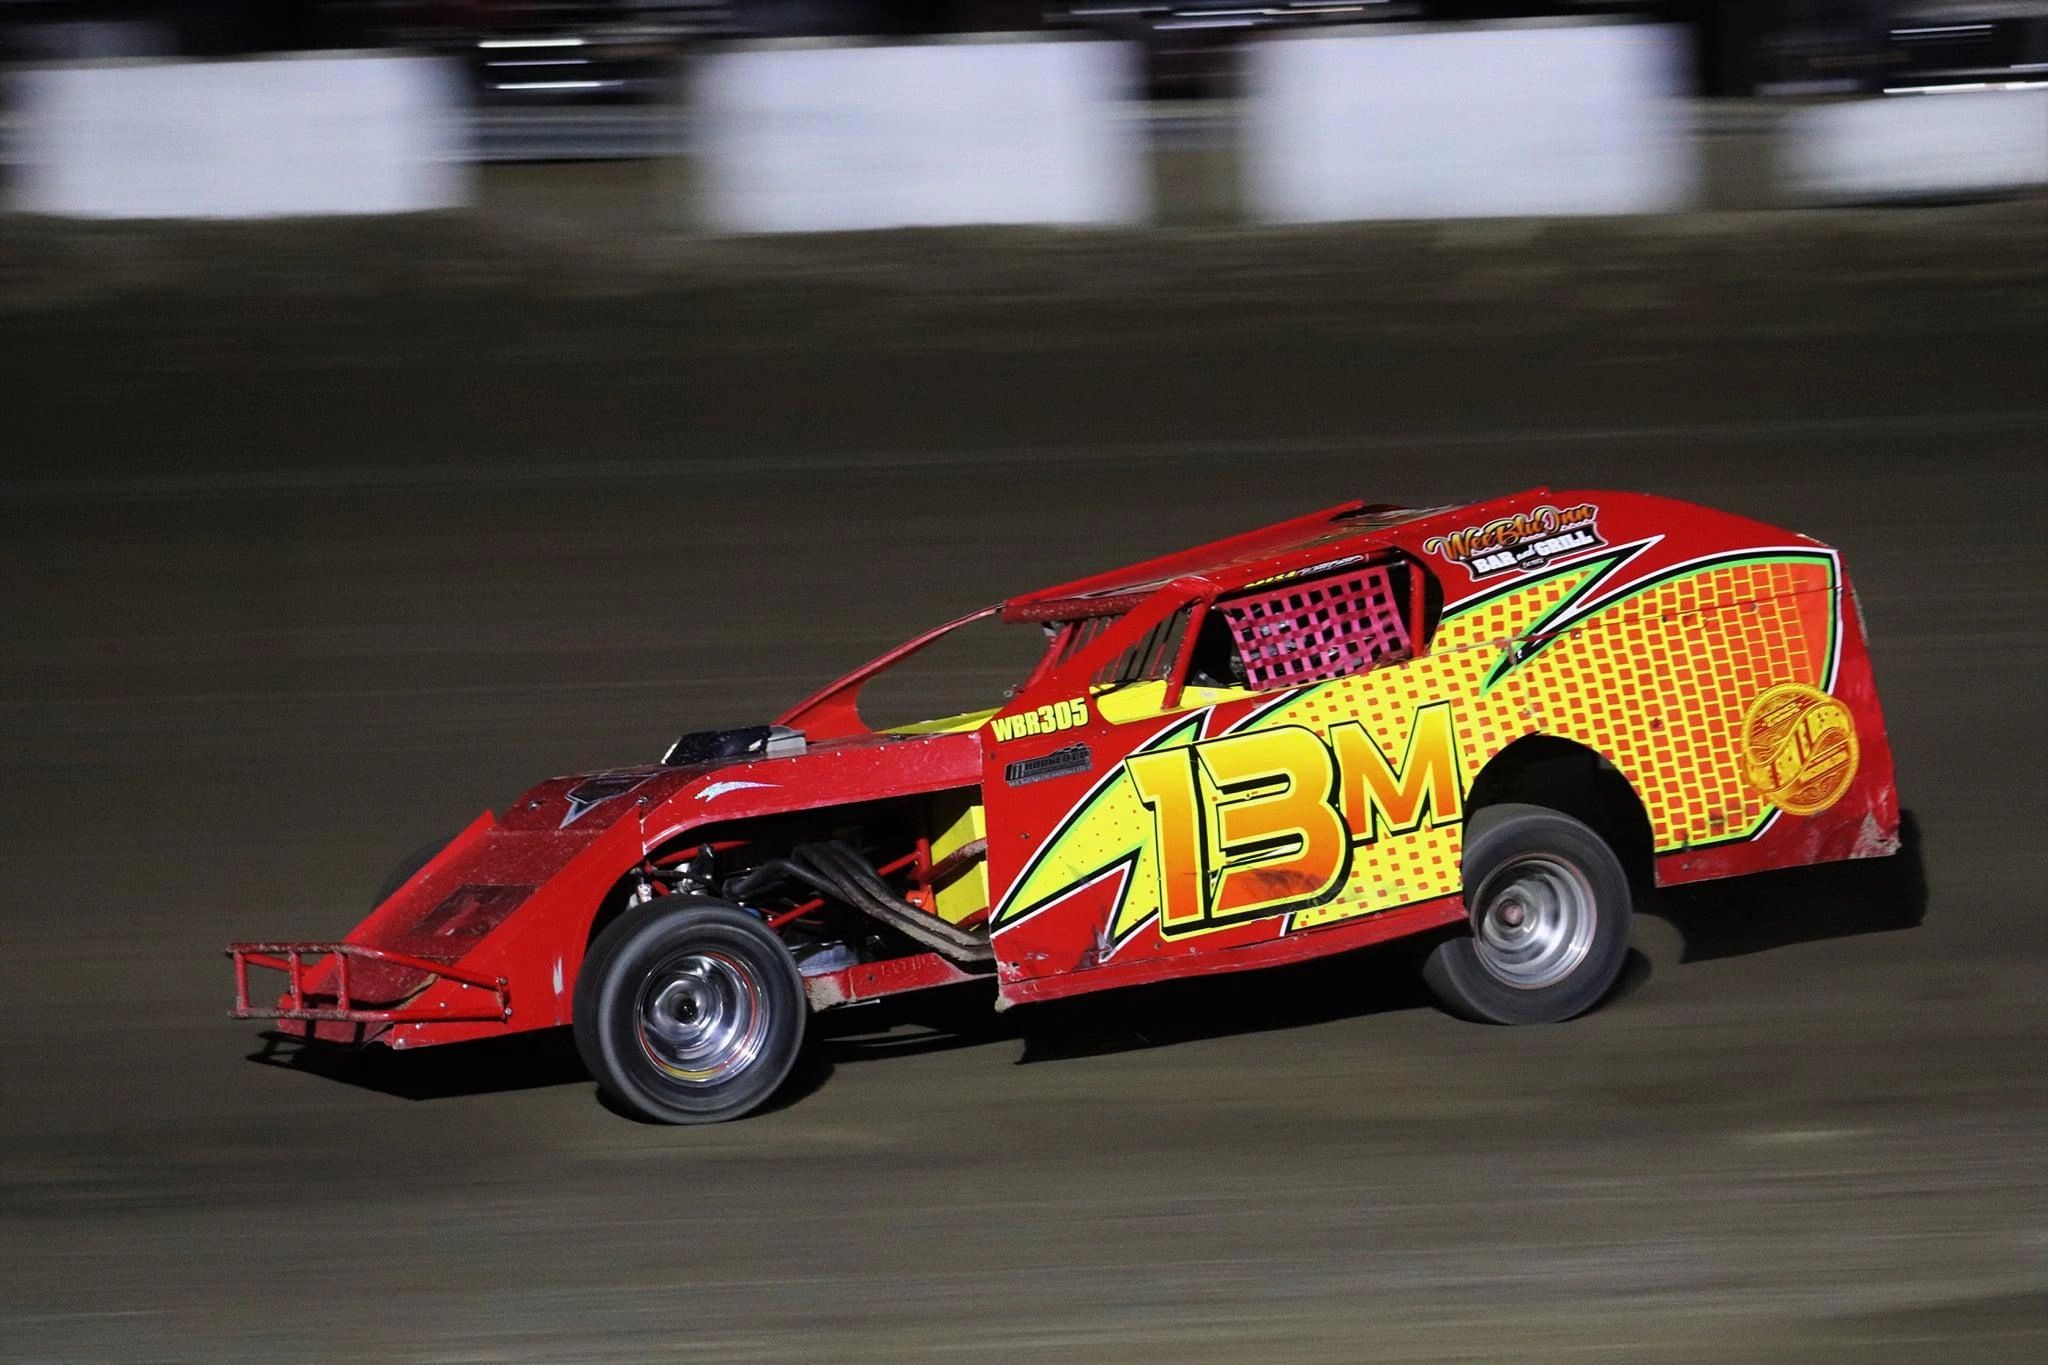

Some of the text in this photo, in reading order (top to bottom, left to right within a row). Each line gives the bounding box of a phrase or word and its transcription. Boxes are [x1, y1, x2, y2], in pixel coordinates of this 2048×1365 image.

[1472, 551, 1517, 573] BAR
[1516, 545, 1535, 560] and
[1534, 530, 1594, 556] GRILL
[990, 697, 1089, 742] WBR305
[1125, 700, 1463, 939] 13M
